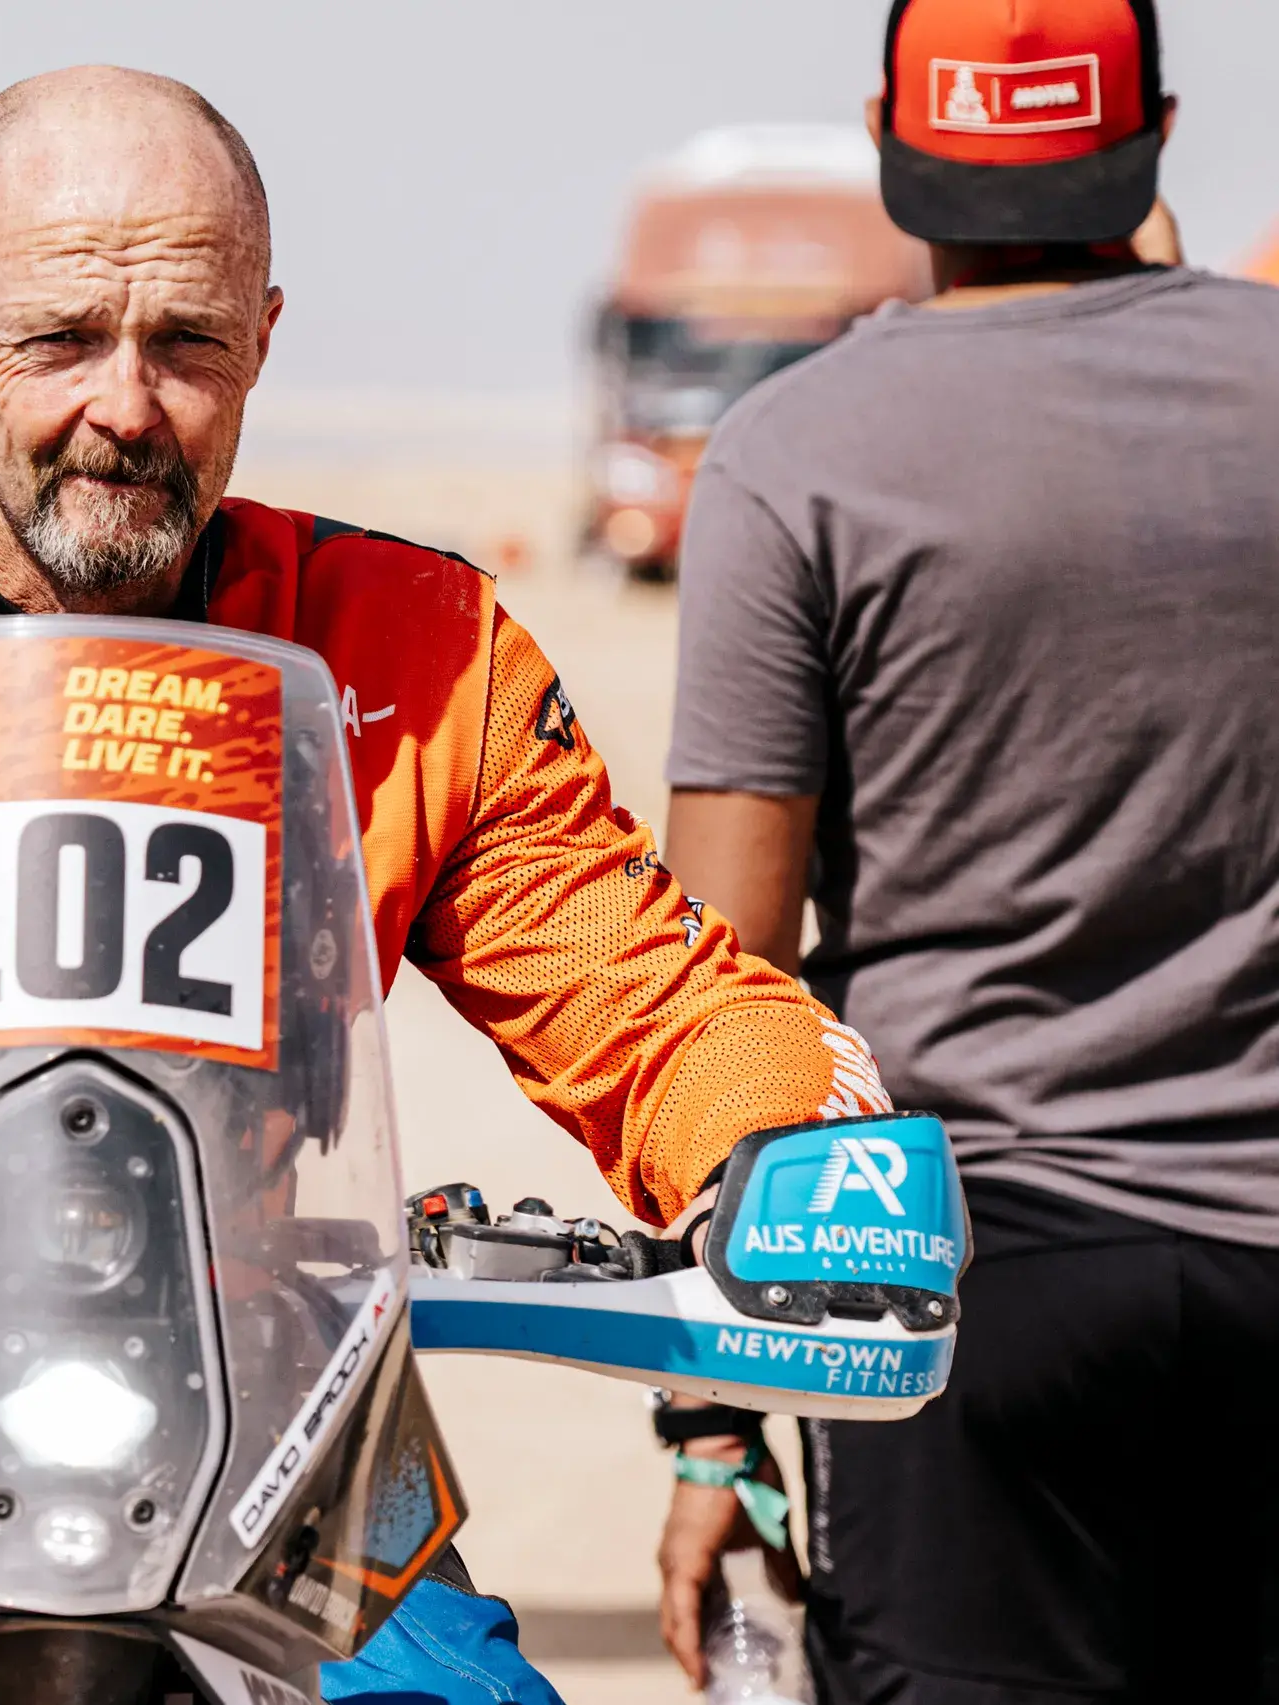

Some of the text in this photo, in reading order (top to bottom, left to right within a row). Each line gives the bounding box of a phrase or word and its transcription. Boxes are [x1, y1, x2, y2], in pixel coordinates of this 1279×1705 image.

[63, 666, 229, 714] DREAM.
[63, 702, 193, 744] DARE.
[62, 739, 215, 784] LIVE IT.
[745, 1224, 957, 1269] AUS ADVENTURE
[717, 1329, 903, 1371] NEWTOWN
[826, 1368, 936, 1394] FITNESS
[242, 1445, 301, 1532] DAVID
[303, 1328, 370, 1440] BROCK
